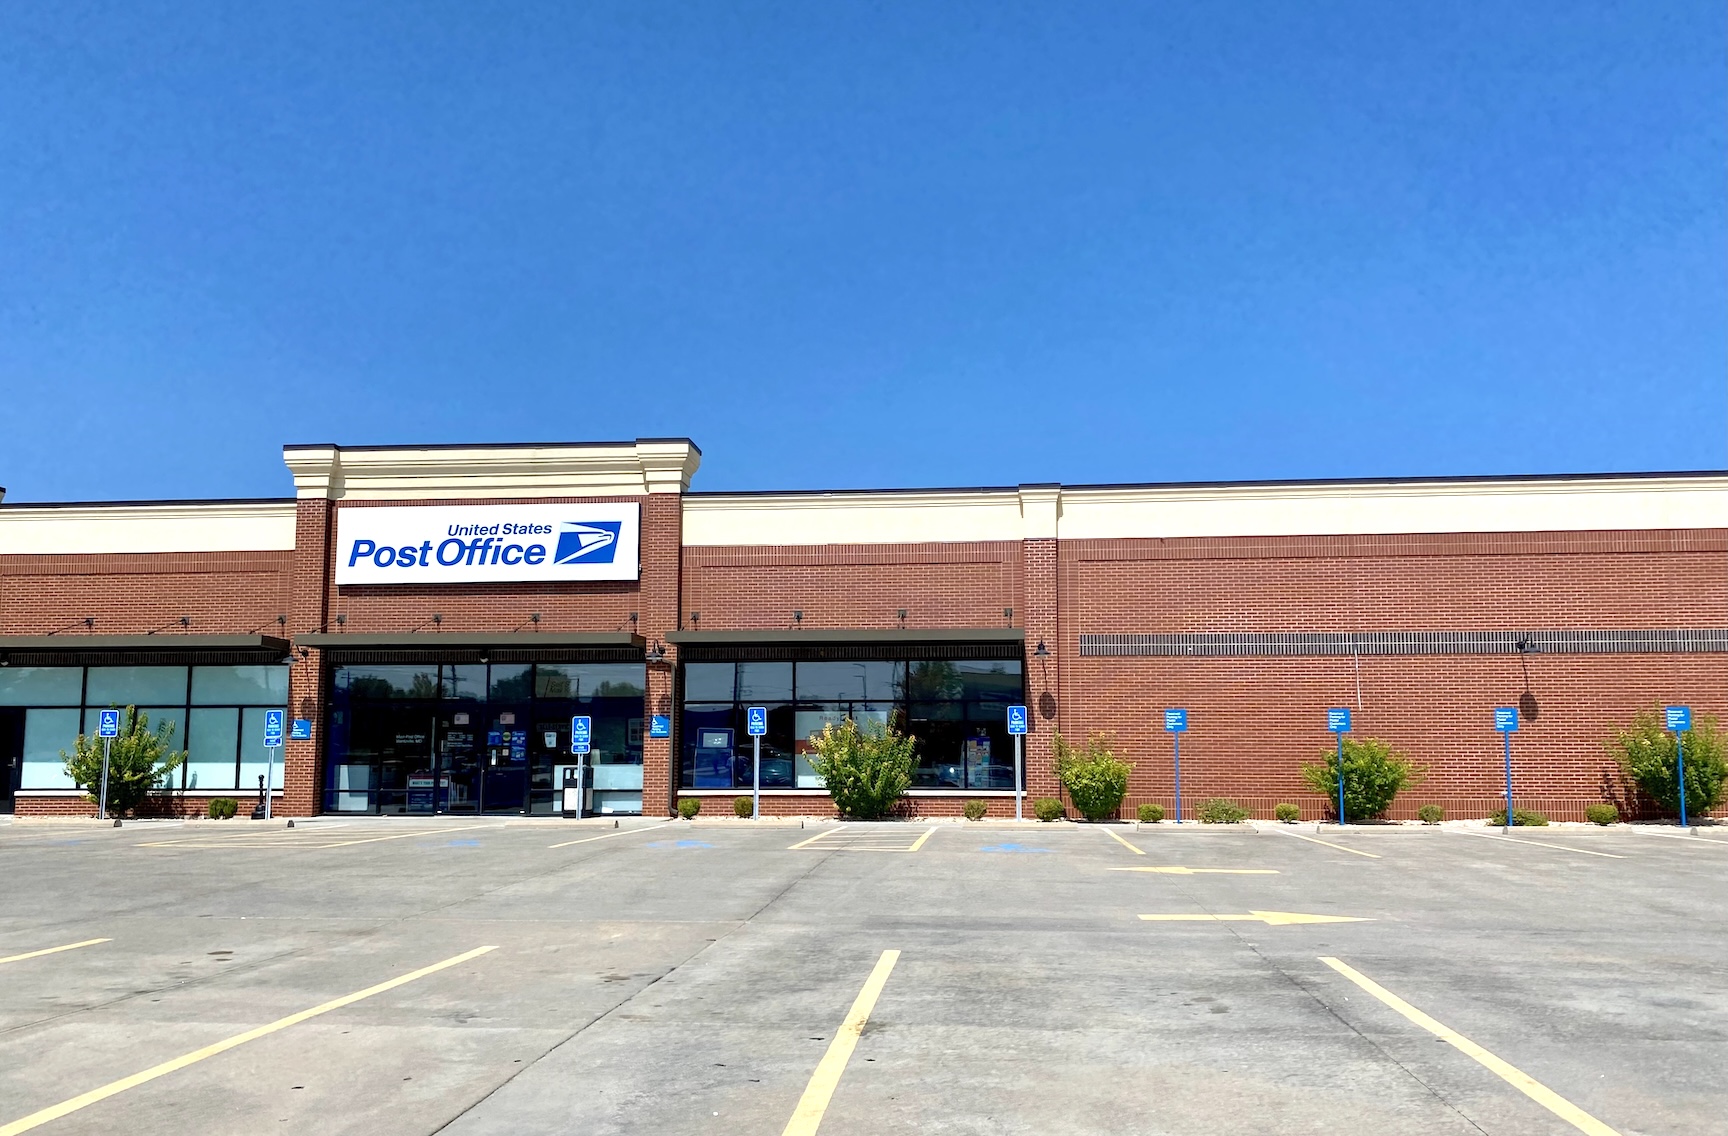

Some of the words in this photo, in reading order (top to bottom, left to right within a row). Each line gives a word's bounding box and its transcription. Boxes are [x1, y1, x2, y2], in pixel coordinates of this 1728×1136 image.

[448, 523, 500, 537] United
[502, 523, 552, 536] States
[348, 539, 434, 568] Post
[436, 538, 547, 567] Office
